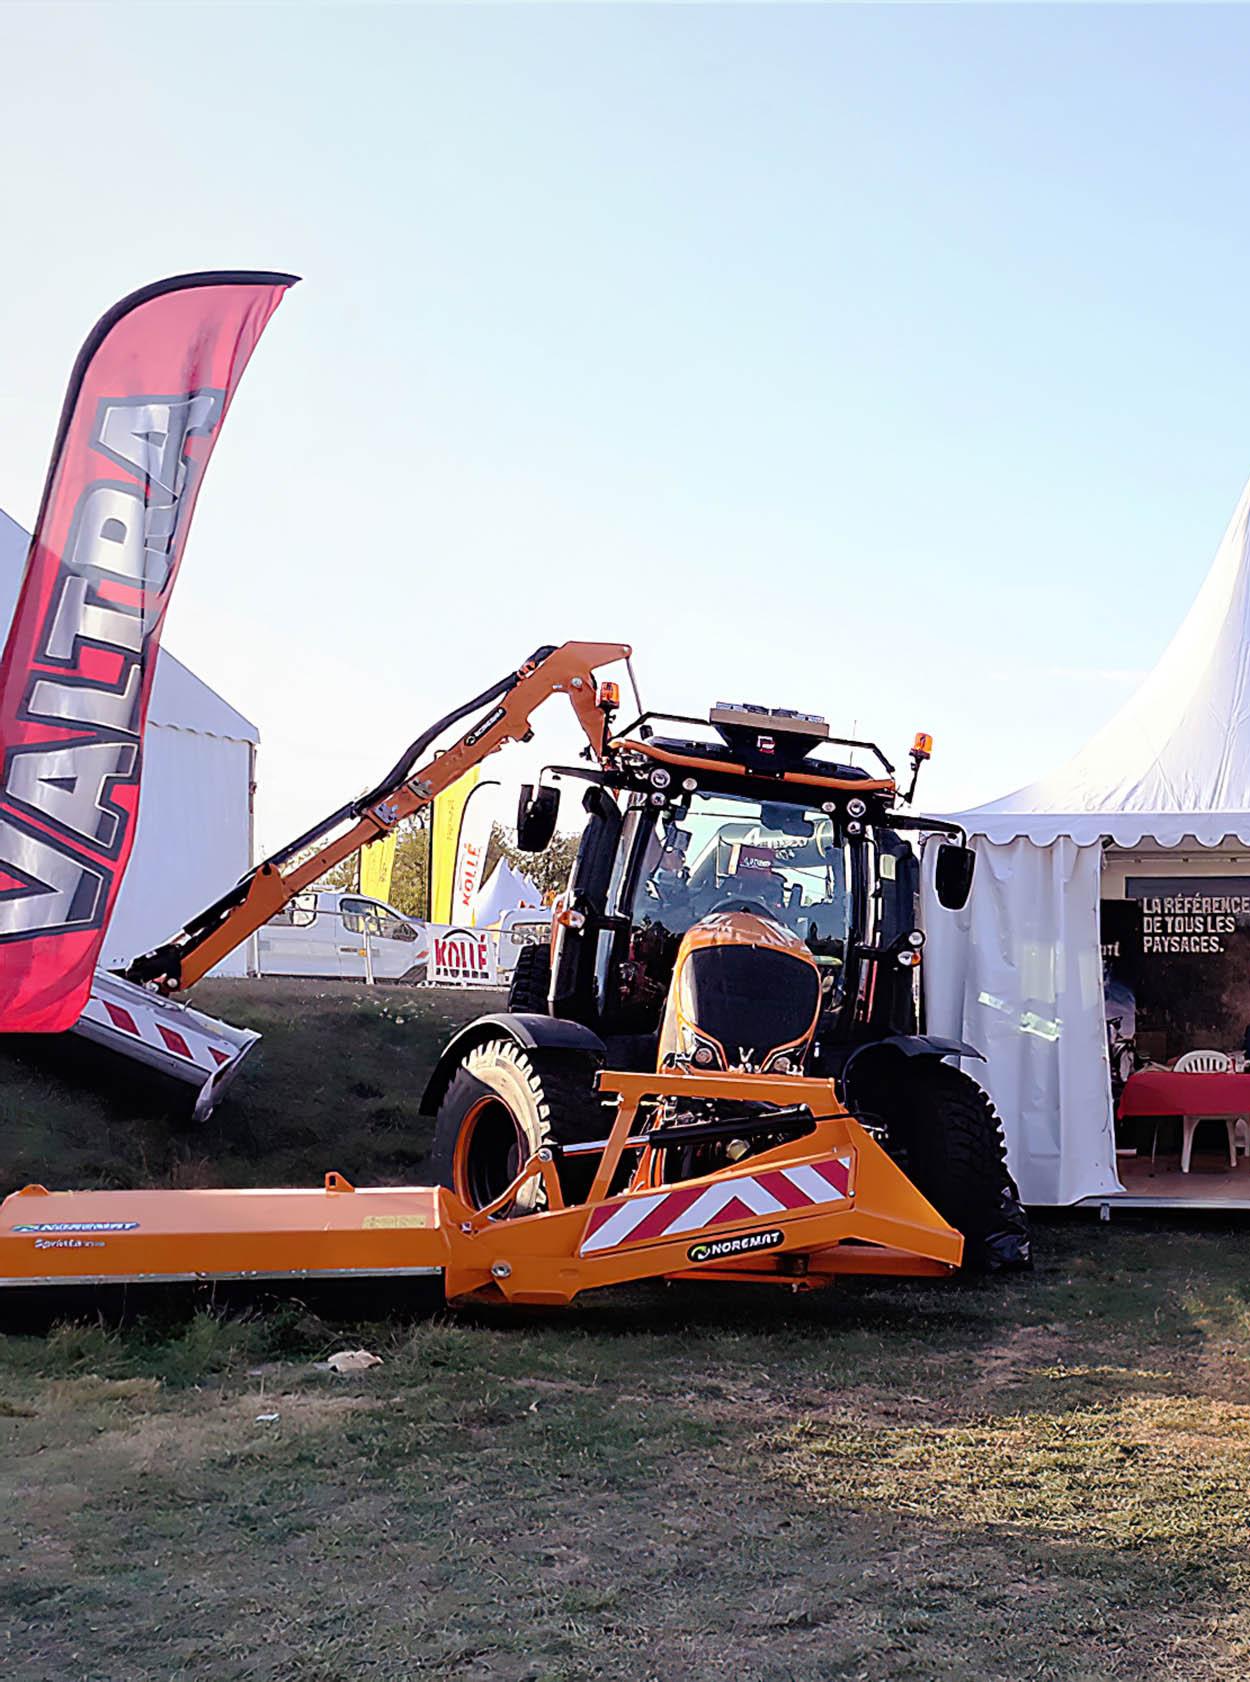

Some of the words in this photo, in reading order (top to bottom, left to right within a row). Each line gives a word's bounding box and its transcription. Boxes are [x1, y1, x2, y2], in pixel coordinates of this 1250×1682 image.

[0, 391, 217, 940] VALTRA
[462, 842, 480, 907] KOLLÉ
[1143, 897, 1162, 914] LA
[1164, 892, 1250, 914] RÉFÉRENCE
[1143, 916, 1163, 933] DE
[1165, 916, 1204, 933] TOUS
[1207, 916, 1235, 934] LES
[434, 934, 489, 979] KOLLÉ
[1143, 936, 1225, 953] PAYSAGES.
[711, 1231, 780, 1255] NOREMAT
